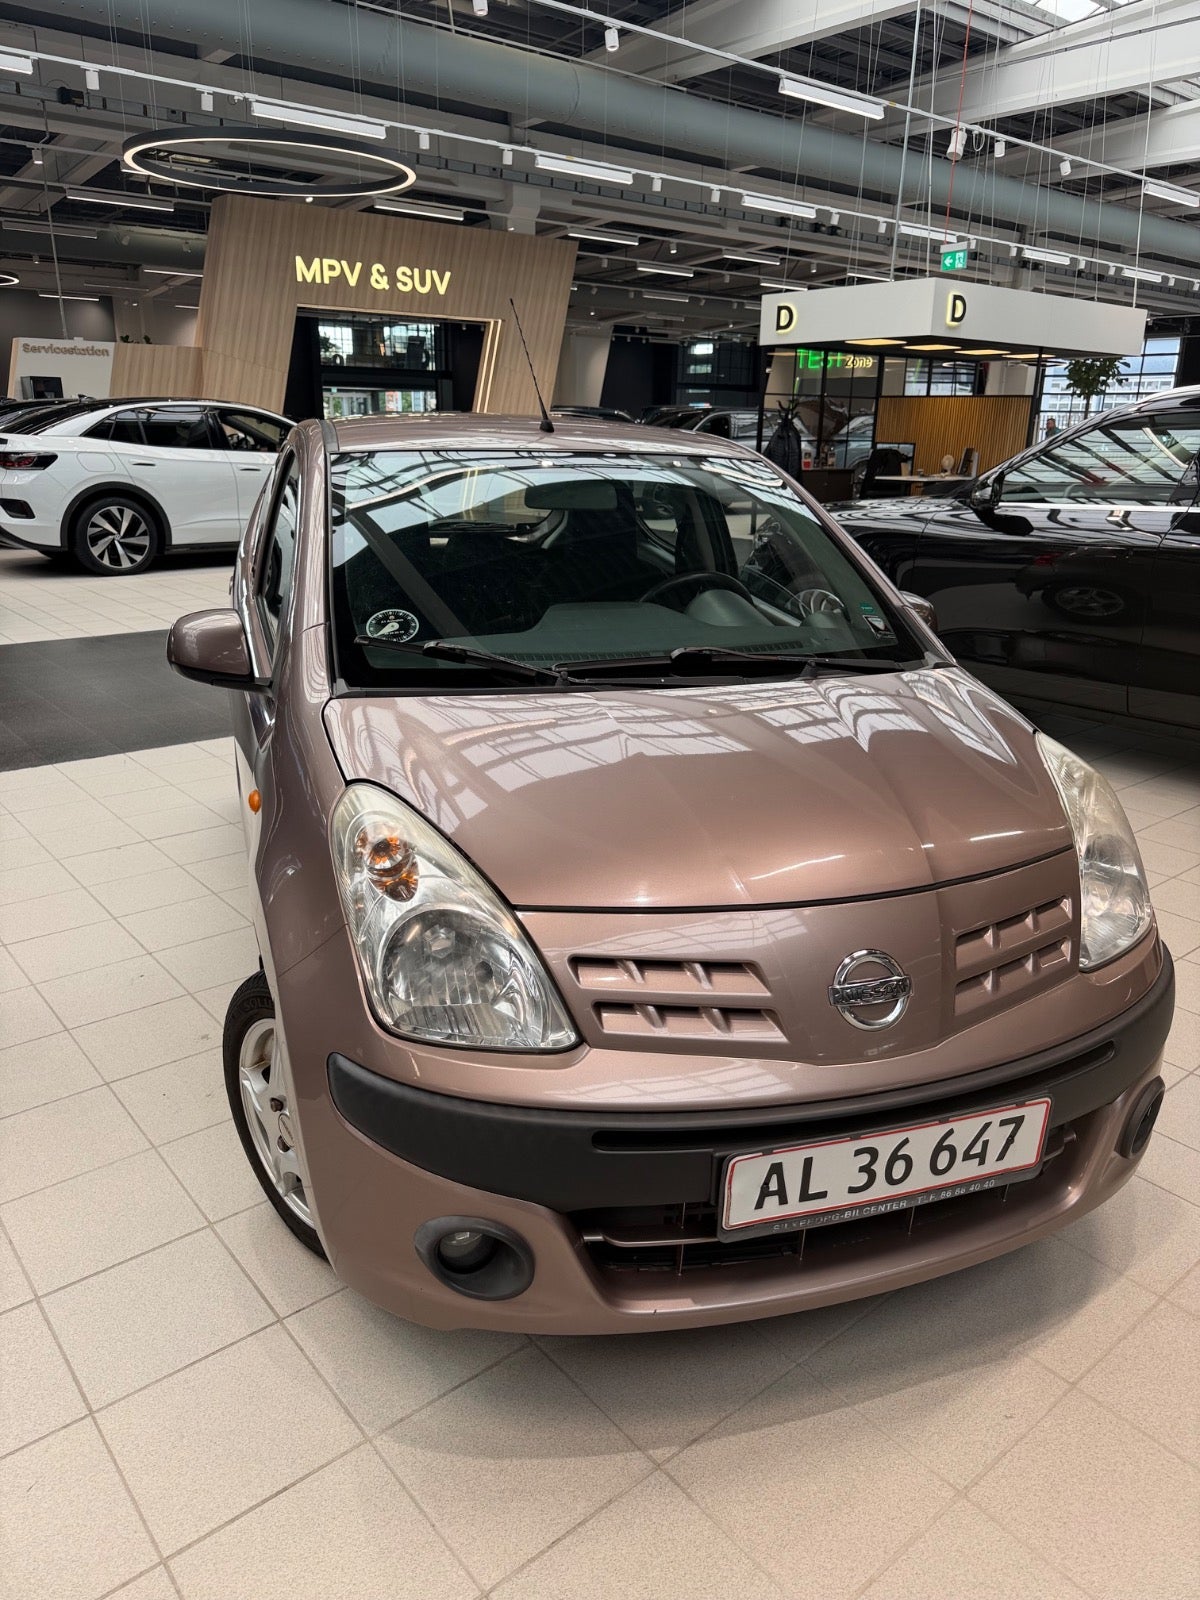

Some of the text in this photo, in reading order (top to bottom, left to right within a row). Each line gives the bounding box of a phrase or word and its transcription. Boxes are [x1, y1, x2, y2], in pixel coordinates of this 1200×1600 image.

[295, 255, 451, 295] MPV & SUV
[775, 304, 796, 332] D
[950, 293, 967, 323] D
[22, 343, 110, 357] Servicestation
[845, 354, 873, 369] Zone
[754, 1114, 1025, 1210] AL 36 647
